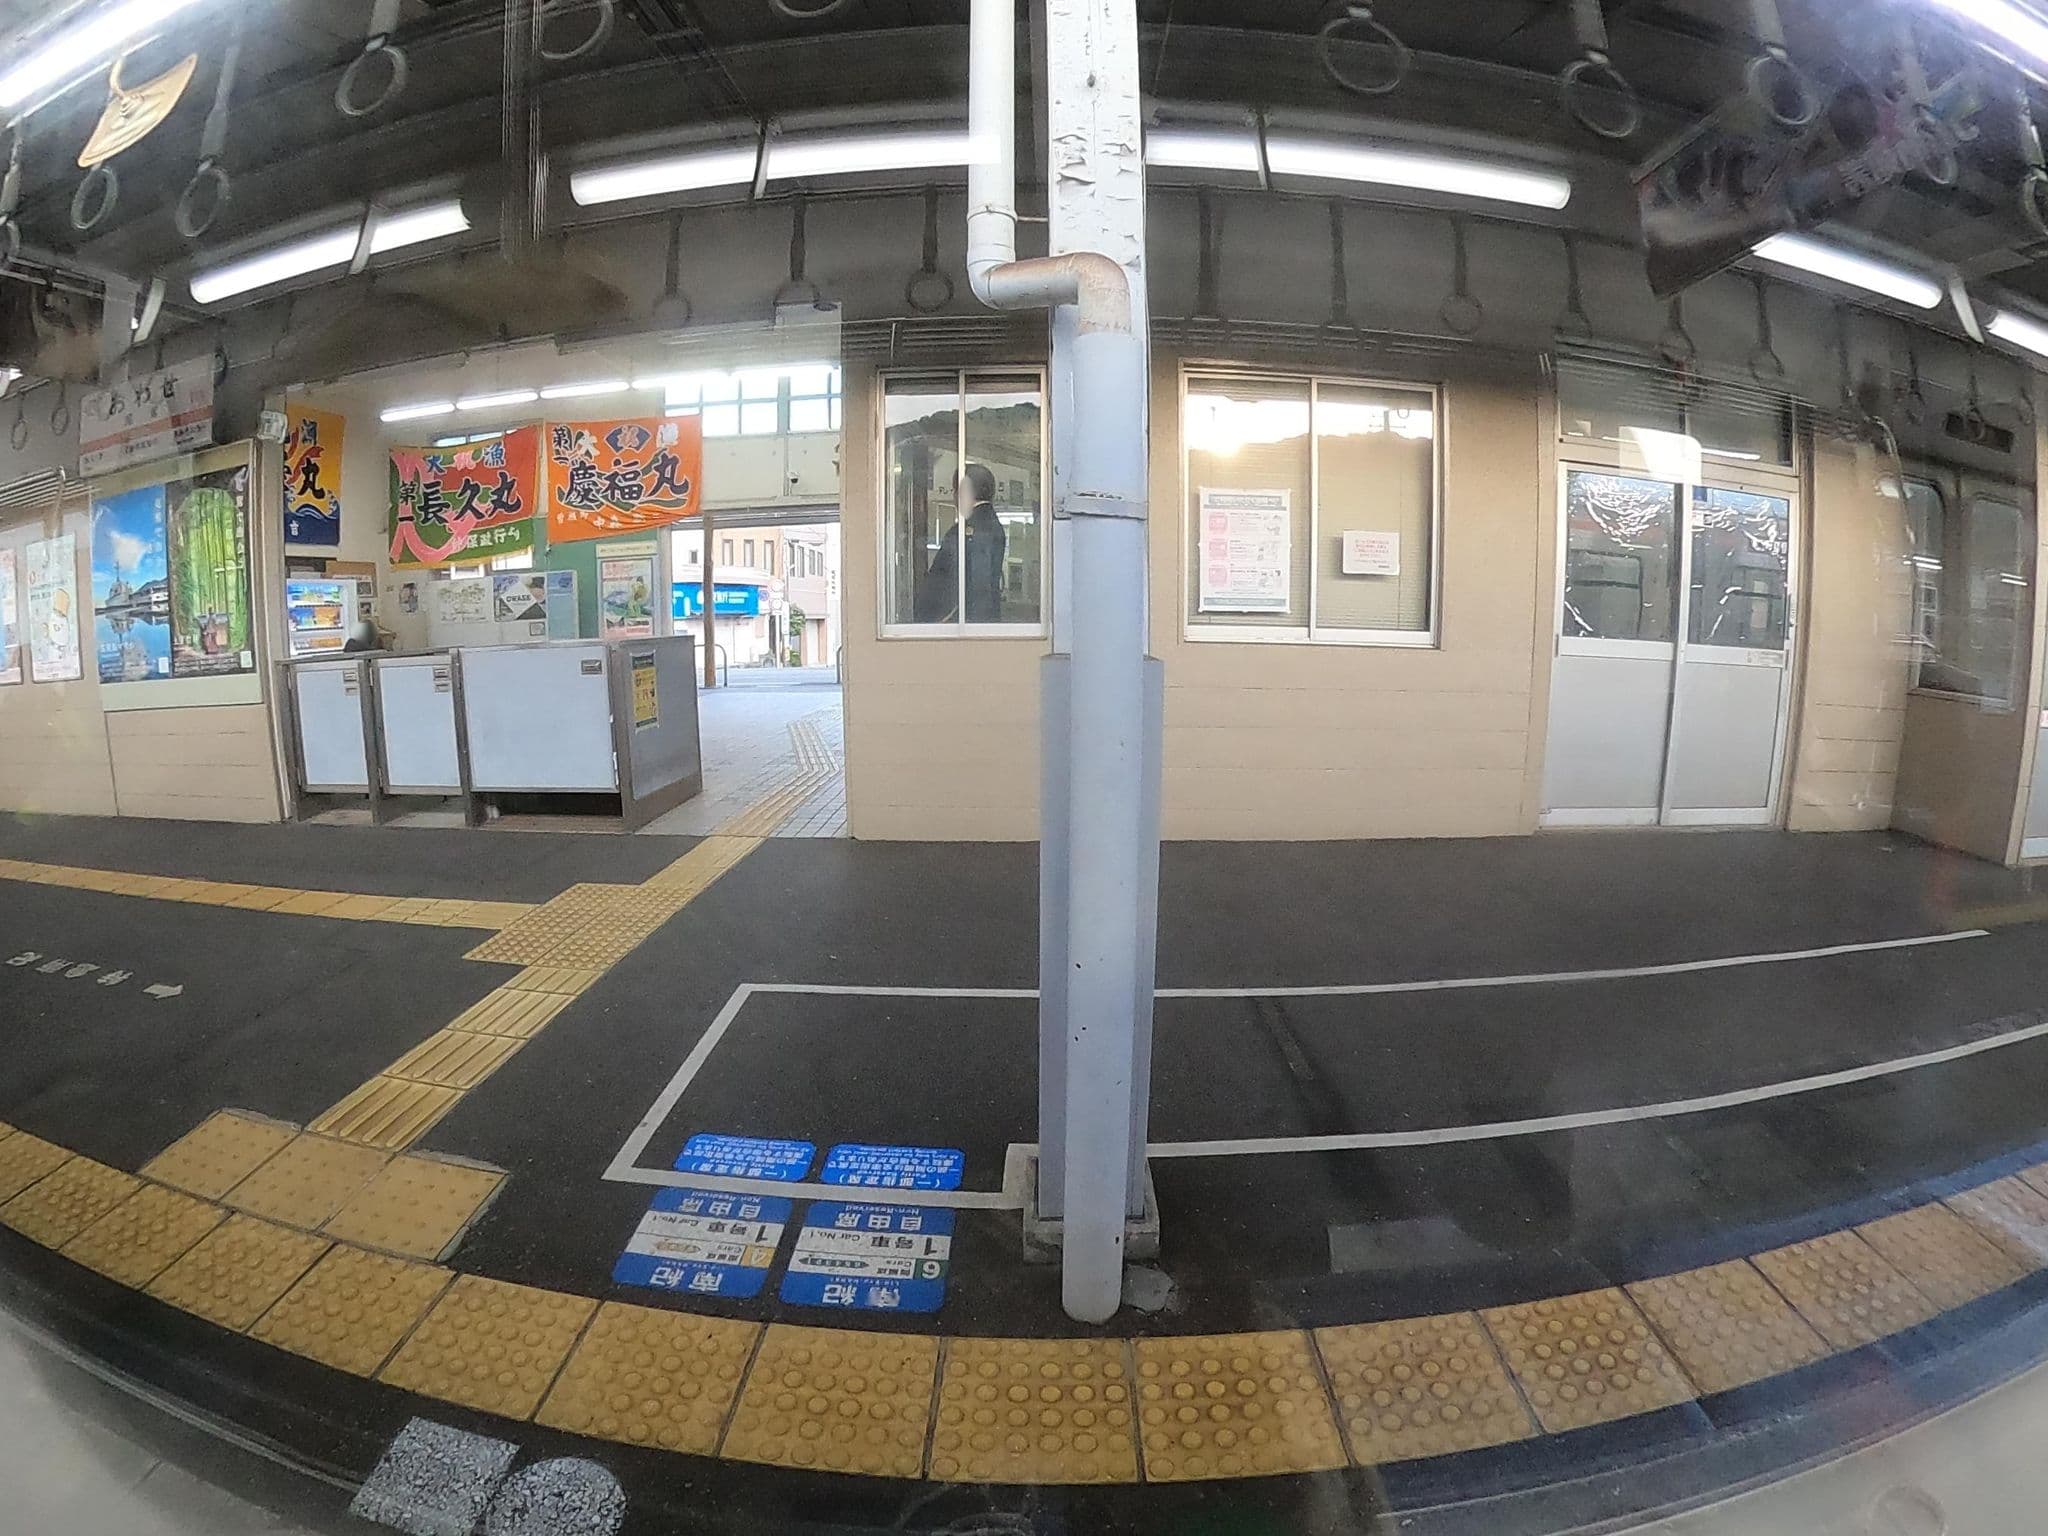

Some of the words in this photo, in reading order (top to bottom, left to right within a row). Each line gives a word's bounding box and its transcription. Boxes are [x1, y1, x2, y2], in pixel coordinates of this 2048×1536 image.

[564, 451, 691, 505] 慶福丸
[398, 481, 419, 523] 第一
[417, 471, 523, 526] 長久丸
[677, 1197, 762, 1219] 自由席
[833, 1211, 922, 1231] 自由席
[841, 1232, 861, 1242] Car
[716, 1245, 742, 1254] Cars
[885, 1260, 912, 1268] Cars
[920, 1260, 941, 1279] 6
[649, 1265, 724, 1292] 南紀
[821, 1284, 901, 1308] 南紀
